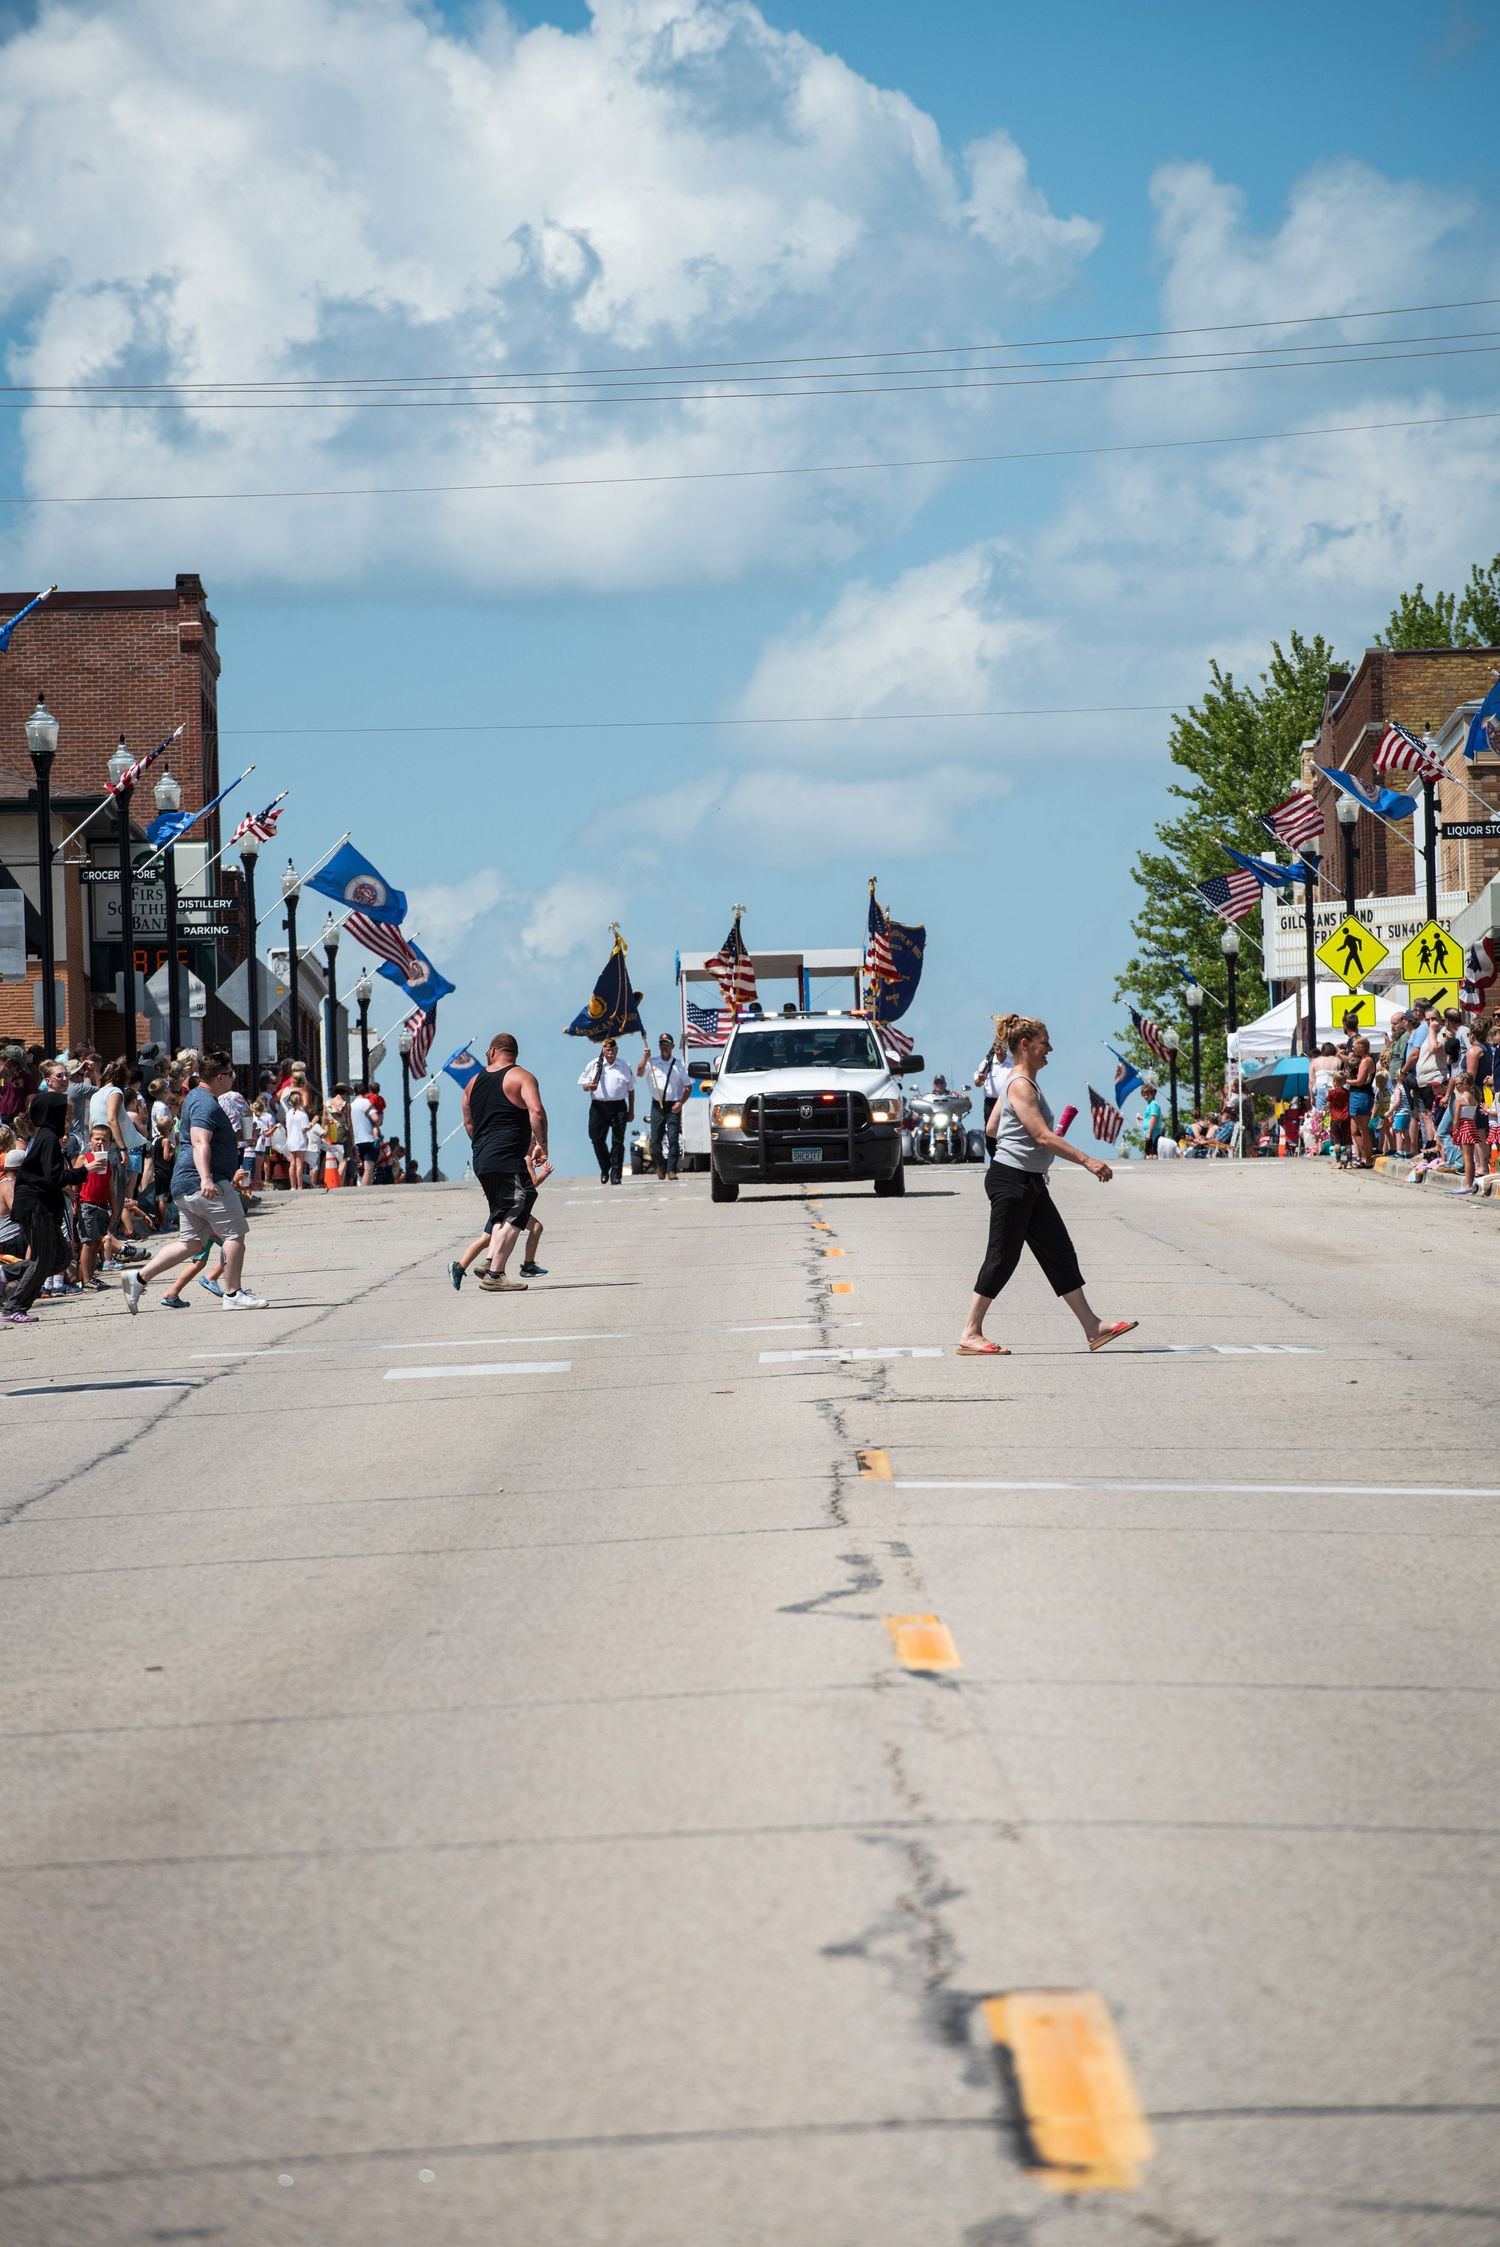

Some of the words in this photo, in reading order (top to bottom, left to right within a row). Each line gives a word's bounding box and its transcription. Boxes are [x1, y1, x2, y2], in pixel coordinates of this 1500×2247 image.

[1447, 826, 1483, 836] LIQUOR
[82, 871, 121, 880] GROCER
[132, 870, 156, 879] TORE
[131, 887, 166, 901] FIRS
[178, 899, 232, 909] DISTILLERY
[1280, 913, 1336, 930] GILLANS
[1340, 909, 1373, 925] ISAND
[184, 926, 229, 935] PARKING
[794, 1151, 821, 1161] SHERIFF
